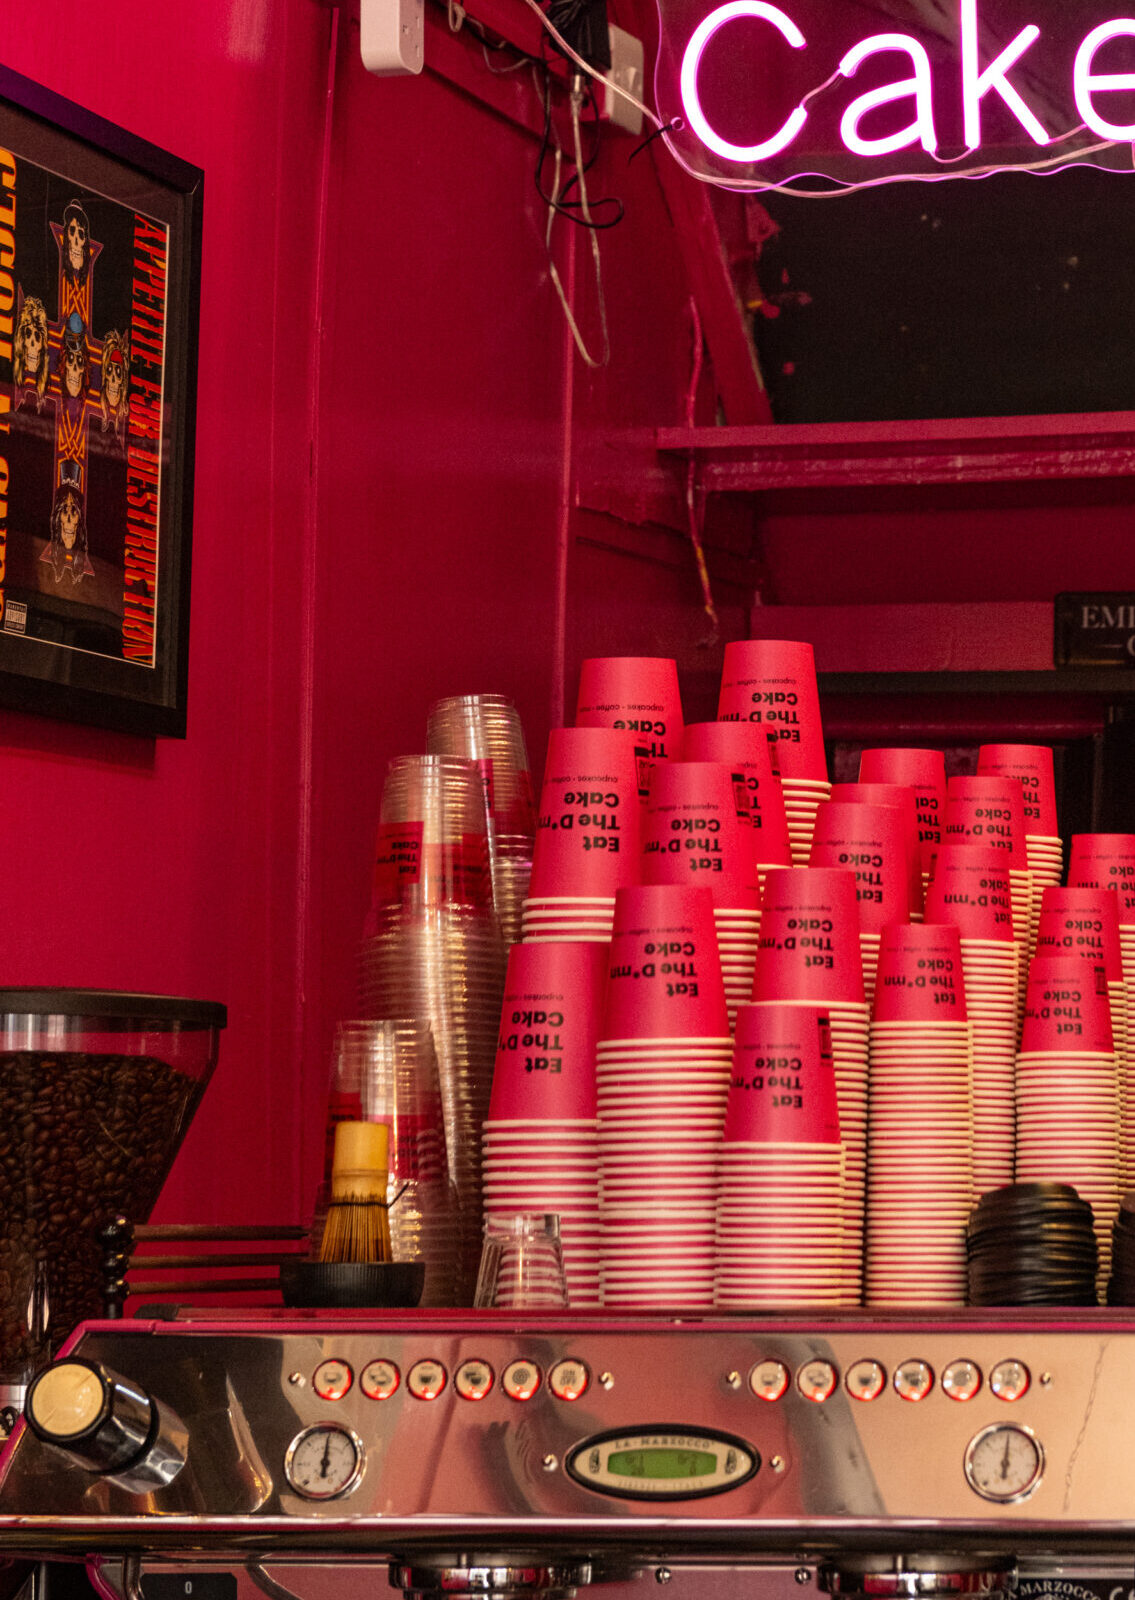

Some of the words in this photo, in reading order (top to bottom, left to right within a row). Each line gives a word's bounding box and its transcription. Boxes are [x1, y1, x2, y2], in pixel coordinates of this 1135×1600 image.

[680, 0, 1135, 162] Cake
[130, 214, 168, 369] APPETITE
[752, 692, 798, 706] Cake
[766, 710, 800, 724] The
[613, 720, 667, 737] Cake
[564, 791, 619, 808] Cake
[578, 813, 621, 830] The
[975, 808, 1012, 822] Cake
[671, 818, 721, 833] Cake
[986, 824, 1013, 838] The
[583, 835, 620, 853] Eat
[685, 838, 723, 853] The
[689, 857, 723, 872] Eat
[839, 853, 883, 868] Cake
[788, 918, 833, 933] Cake
[1065, 920, 1103, 933] Cake
[643, 942, 696, 957] Cake
[799, 937, 834, 952] The
[1076, 936, 1104, 949] The
[805, 955, 834, 970] Eat
[917, 960, 954, 973] Cake
[660, 962, 697, 979] The
[666, 982, 699, 998] Eat
[929, 976, 955, 990] The
[934, 993, 956, 1006] Eat
[1043, 990, 1082, 1003] Cake
[511, 1010, 564, 1029] Cake
[1053, 1006, 1083, 1019] The
[1057, 1022, 1083, 1036] Eat
[521, 1034, 564, 1052] The
[525, 1056, 562, 1075] Eat
[755, 1057, 803, 1072] Cake
[767, 1076, 804, 1091] The
[772, 1094, 803, 1109] Eat
